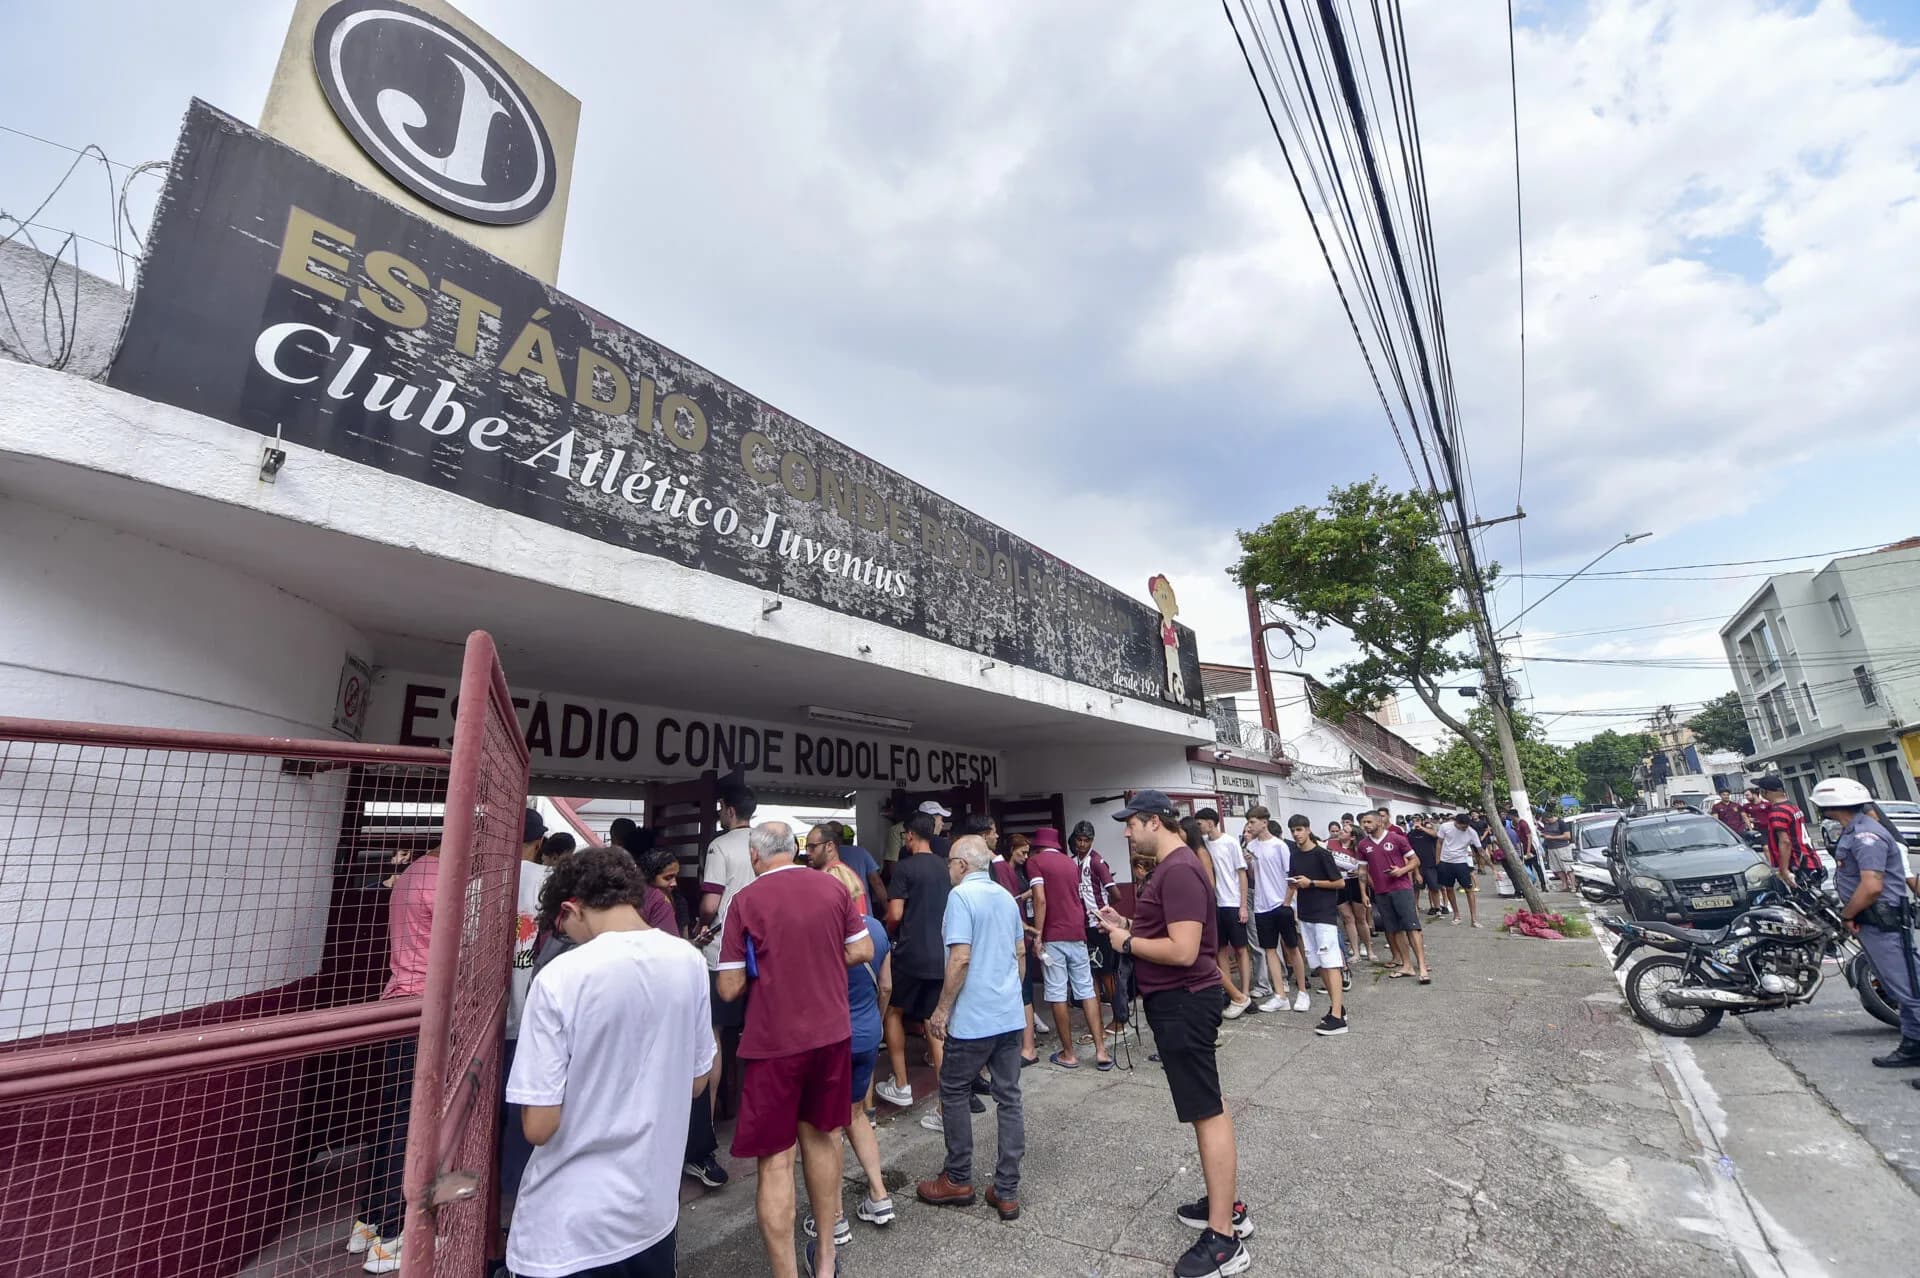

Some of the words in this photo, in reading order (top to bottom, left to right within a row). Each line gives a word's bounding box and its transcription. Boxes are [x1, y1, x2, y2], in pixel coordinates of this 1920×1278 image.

[376, 52, 510, 187] J
[276, 206, 708, 454] ESTÁDIO
[741, 430, 911, 545] CONDE
[254, 321, 510, 453] Clube
[521, 430, 740, 537] Atlético
[751, 508, 908, 598] Juventus
[399, 683, 639, 762] EADIO
[655, 717, 783, 774] CONDE
[795, 733, 921, 783] RODOLFO
[927, 749, 999, 787] CRESPI
[1113, 669, 1138, 692] desde
[1141, 678, 1160, 698] 1924
[1222, 775, 1255, 788] BILHETERIA
